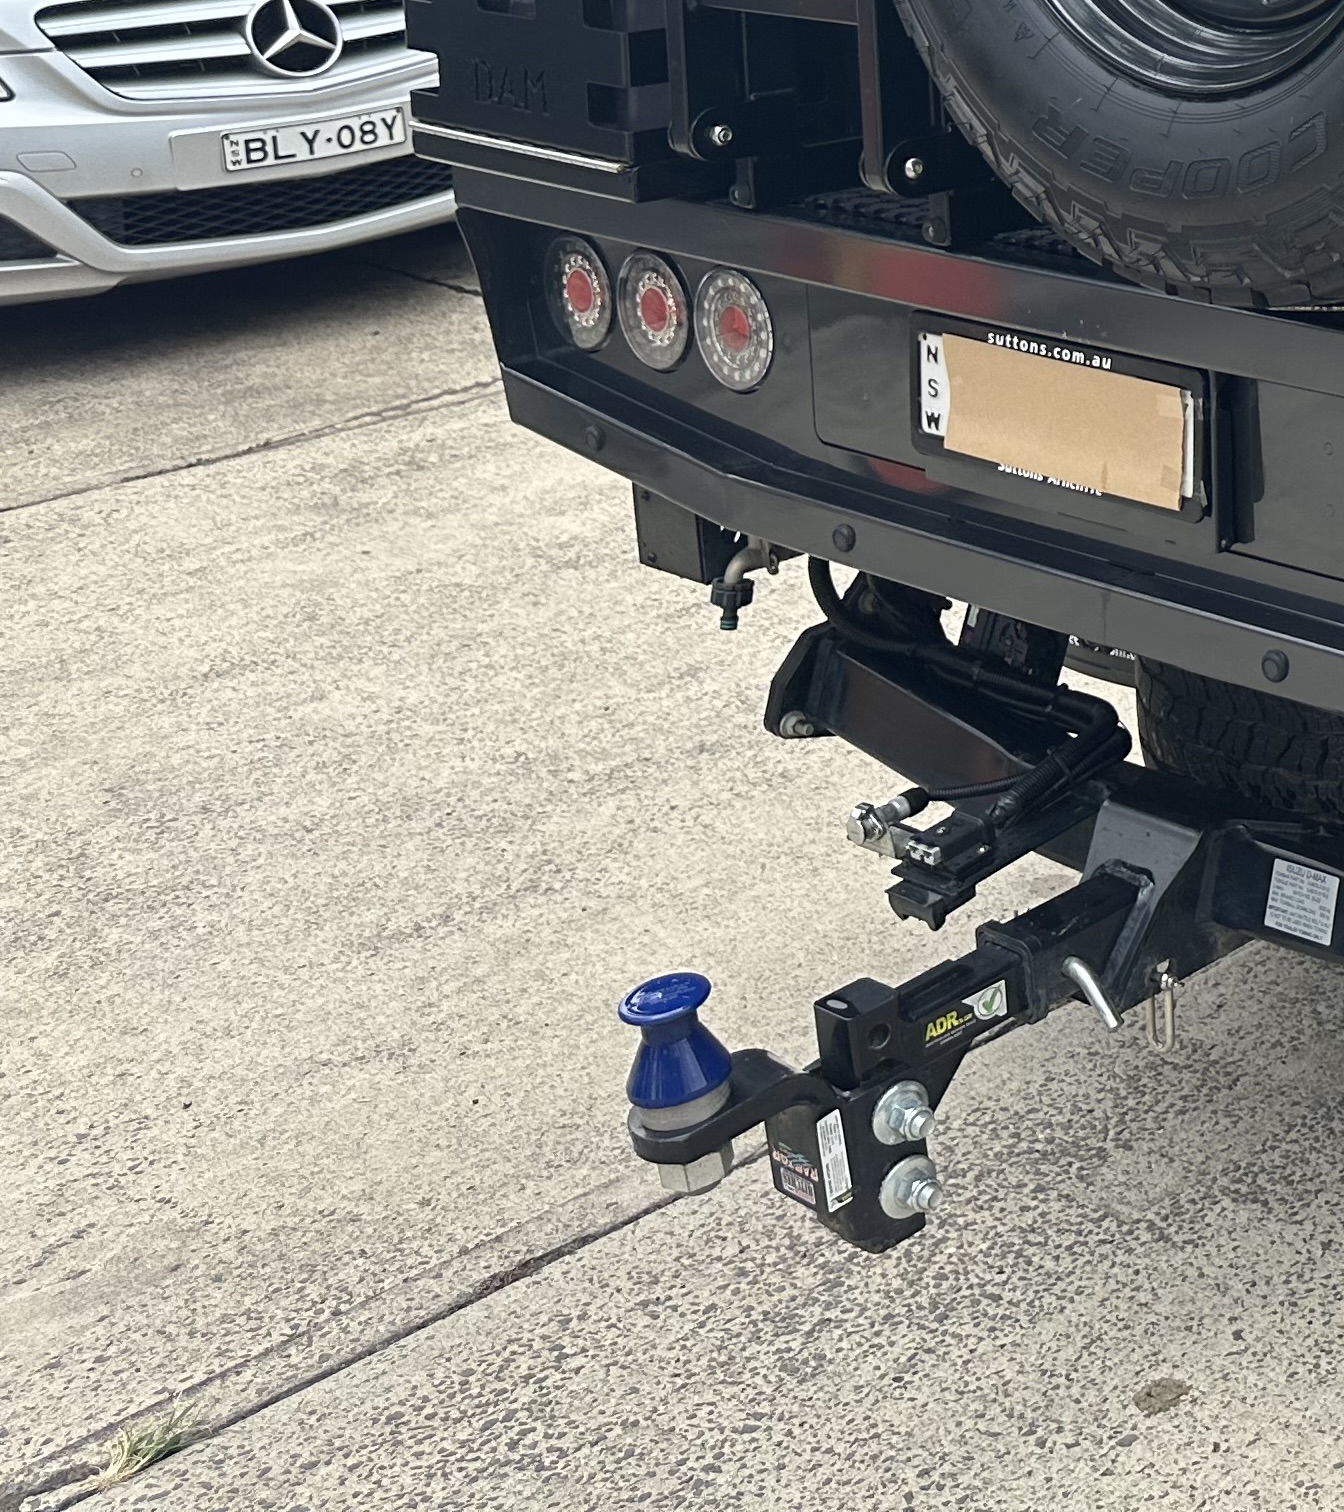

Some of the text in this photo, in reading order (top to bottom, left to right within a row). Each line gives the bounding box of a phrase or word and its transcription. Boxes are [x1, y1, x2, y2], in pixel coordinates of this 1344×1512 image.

[470, 56, 550, 117] DAM
[1031, 101, 1328, 201] COOPER
[987, 332, 1112, 370] suttons.com.au
[925, 1010, 959, 1042] ADR
